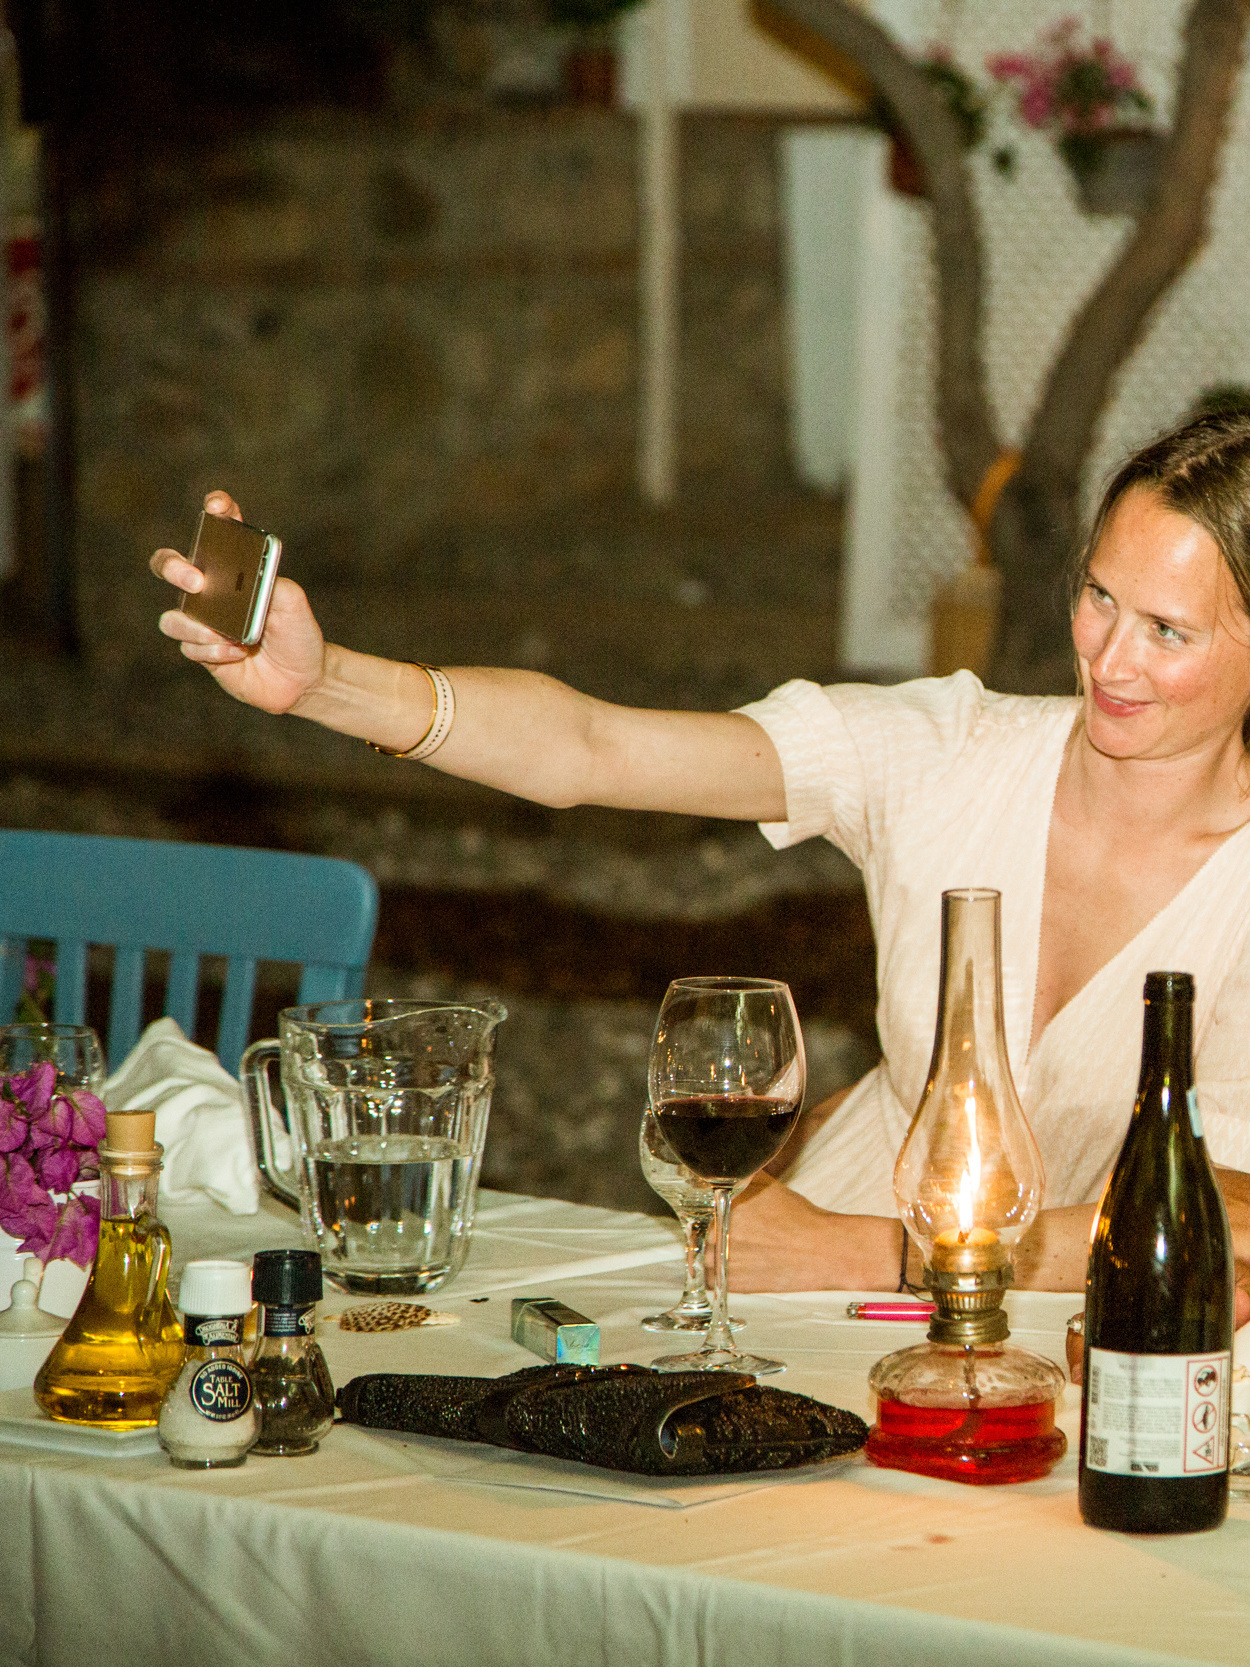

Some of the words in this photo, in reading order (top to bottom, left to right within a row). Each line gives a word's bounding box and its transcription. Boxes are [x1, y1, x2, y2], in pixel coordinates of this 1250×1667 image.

[209, 1374, 233, 1383] TABLE
[201, 1382, 240, 1406] SALT
[217, 1396, 241, 1408] MILL
